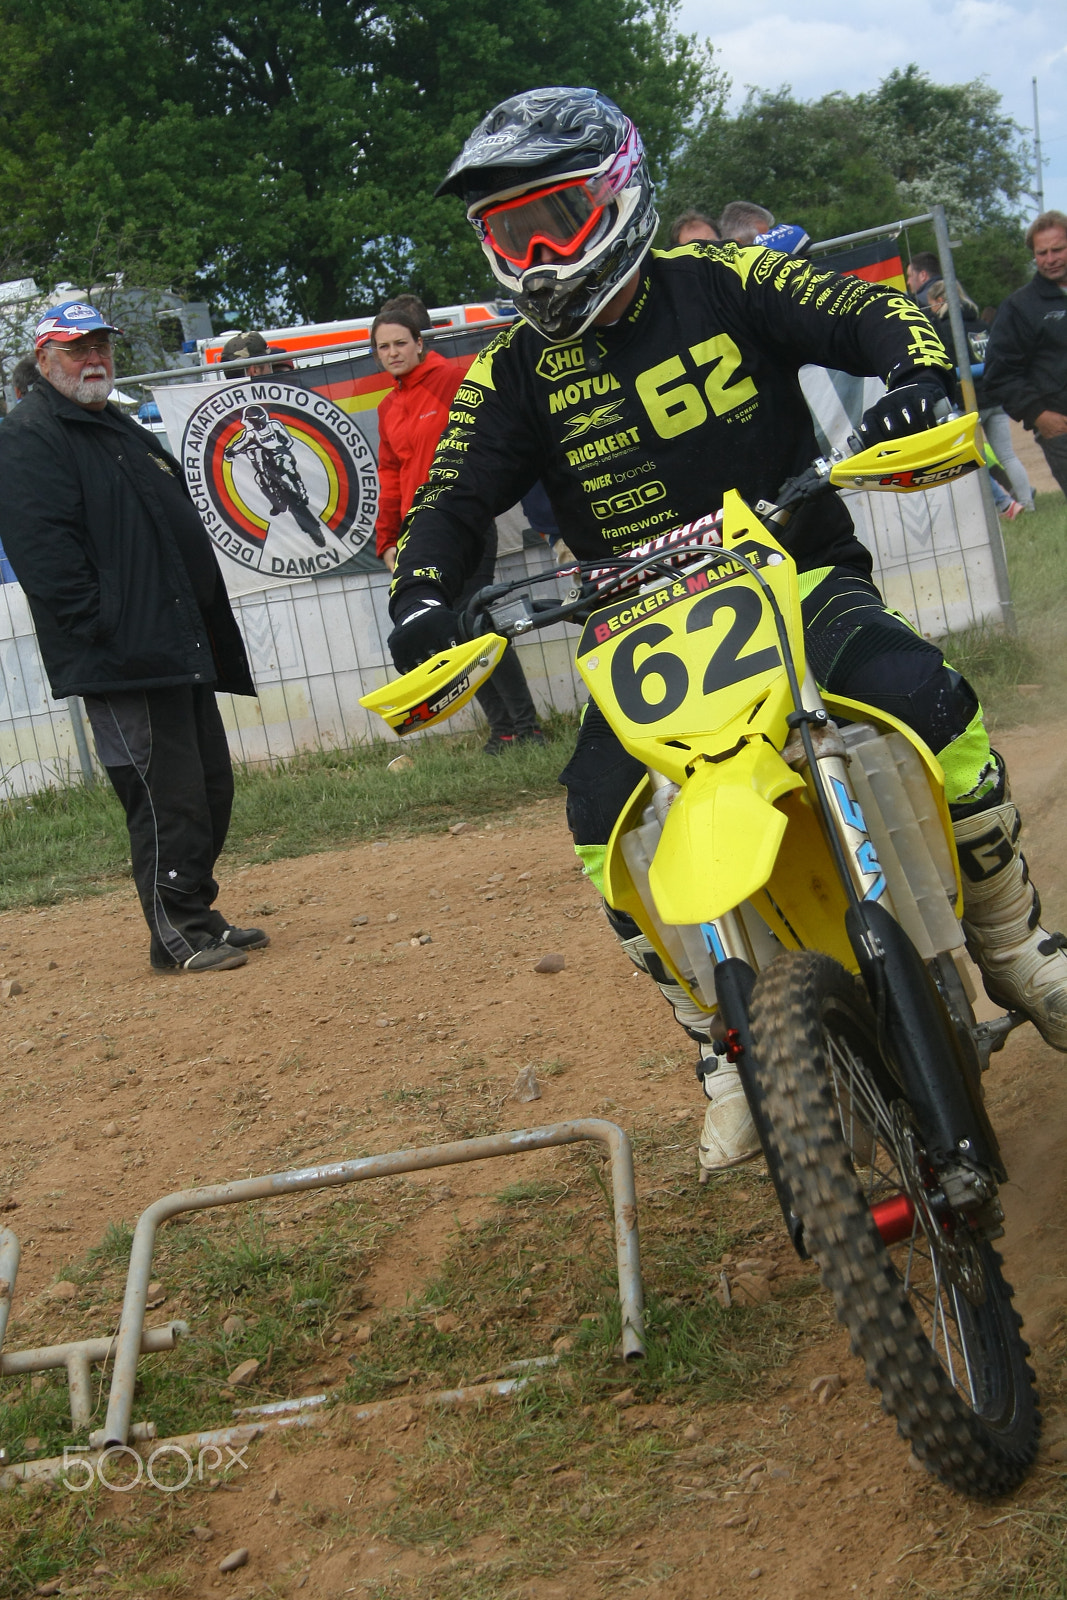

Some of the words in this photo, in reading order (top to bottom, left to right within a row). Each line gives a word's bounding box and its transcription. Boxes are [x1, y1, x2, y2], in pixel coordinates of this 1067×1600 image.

[251, 385, 310, 407] MOTO
[548, 371, 621, 414] MOTUL
[635, 332, 759, 440] 62
[187, 389, 247, 452] AMATEUR
[313, 400, 367, 459] CROSS
[565, 426, 641, 466] RICKERT
[613, 460, 657, 483] brands
[187, 456, 254, 563] DEUTSCHER
[349, 462, 378, 546] VERBAND
[590, 480, 667, 520] OGIO
[601, 509, 679, 539] frameworx.
[271, 549, 341, 575] DAMCV
[593, 590, 671, 644] BECKER
[672, 583, 688, 598] &
[610, 585, 783, 725] 62
